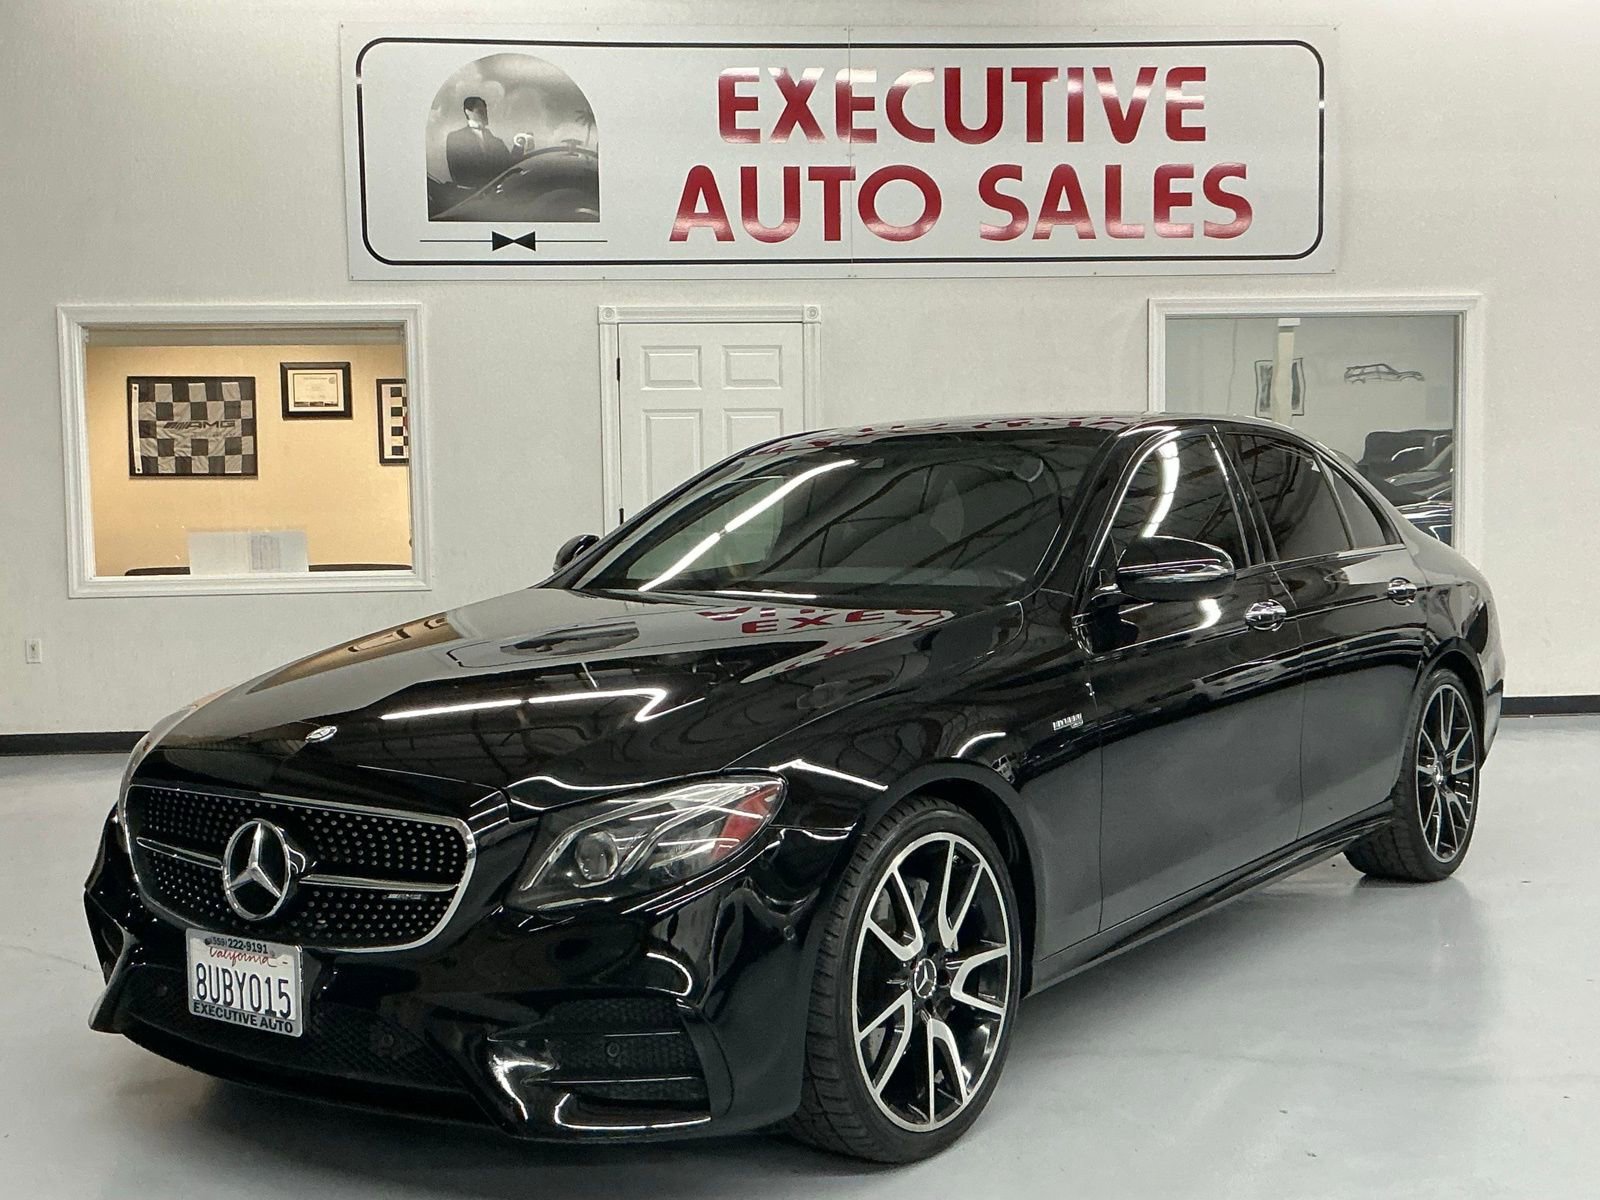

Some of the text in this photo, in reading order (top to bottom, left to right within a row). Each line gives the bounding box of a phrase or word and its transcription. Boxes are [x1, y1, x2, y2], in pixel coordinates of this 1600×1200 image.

[717, 66, 1206, 144] EXECUTIVE
[669, 163, 1253, 243] AUTO SALES
[193, 1001, 294, 1034] EXECUTIVE AUTO
[196, 962, 291, 1019] 8UBY015
